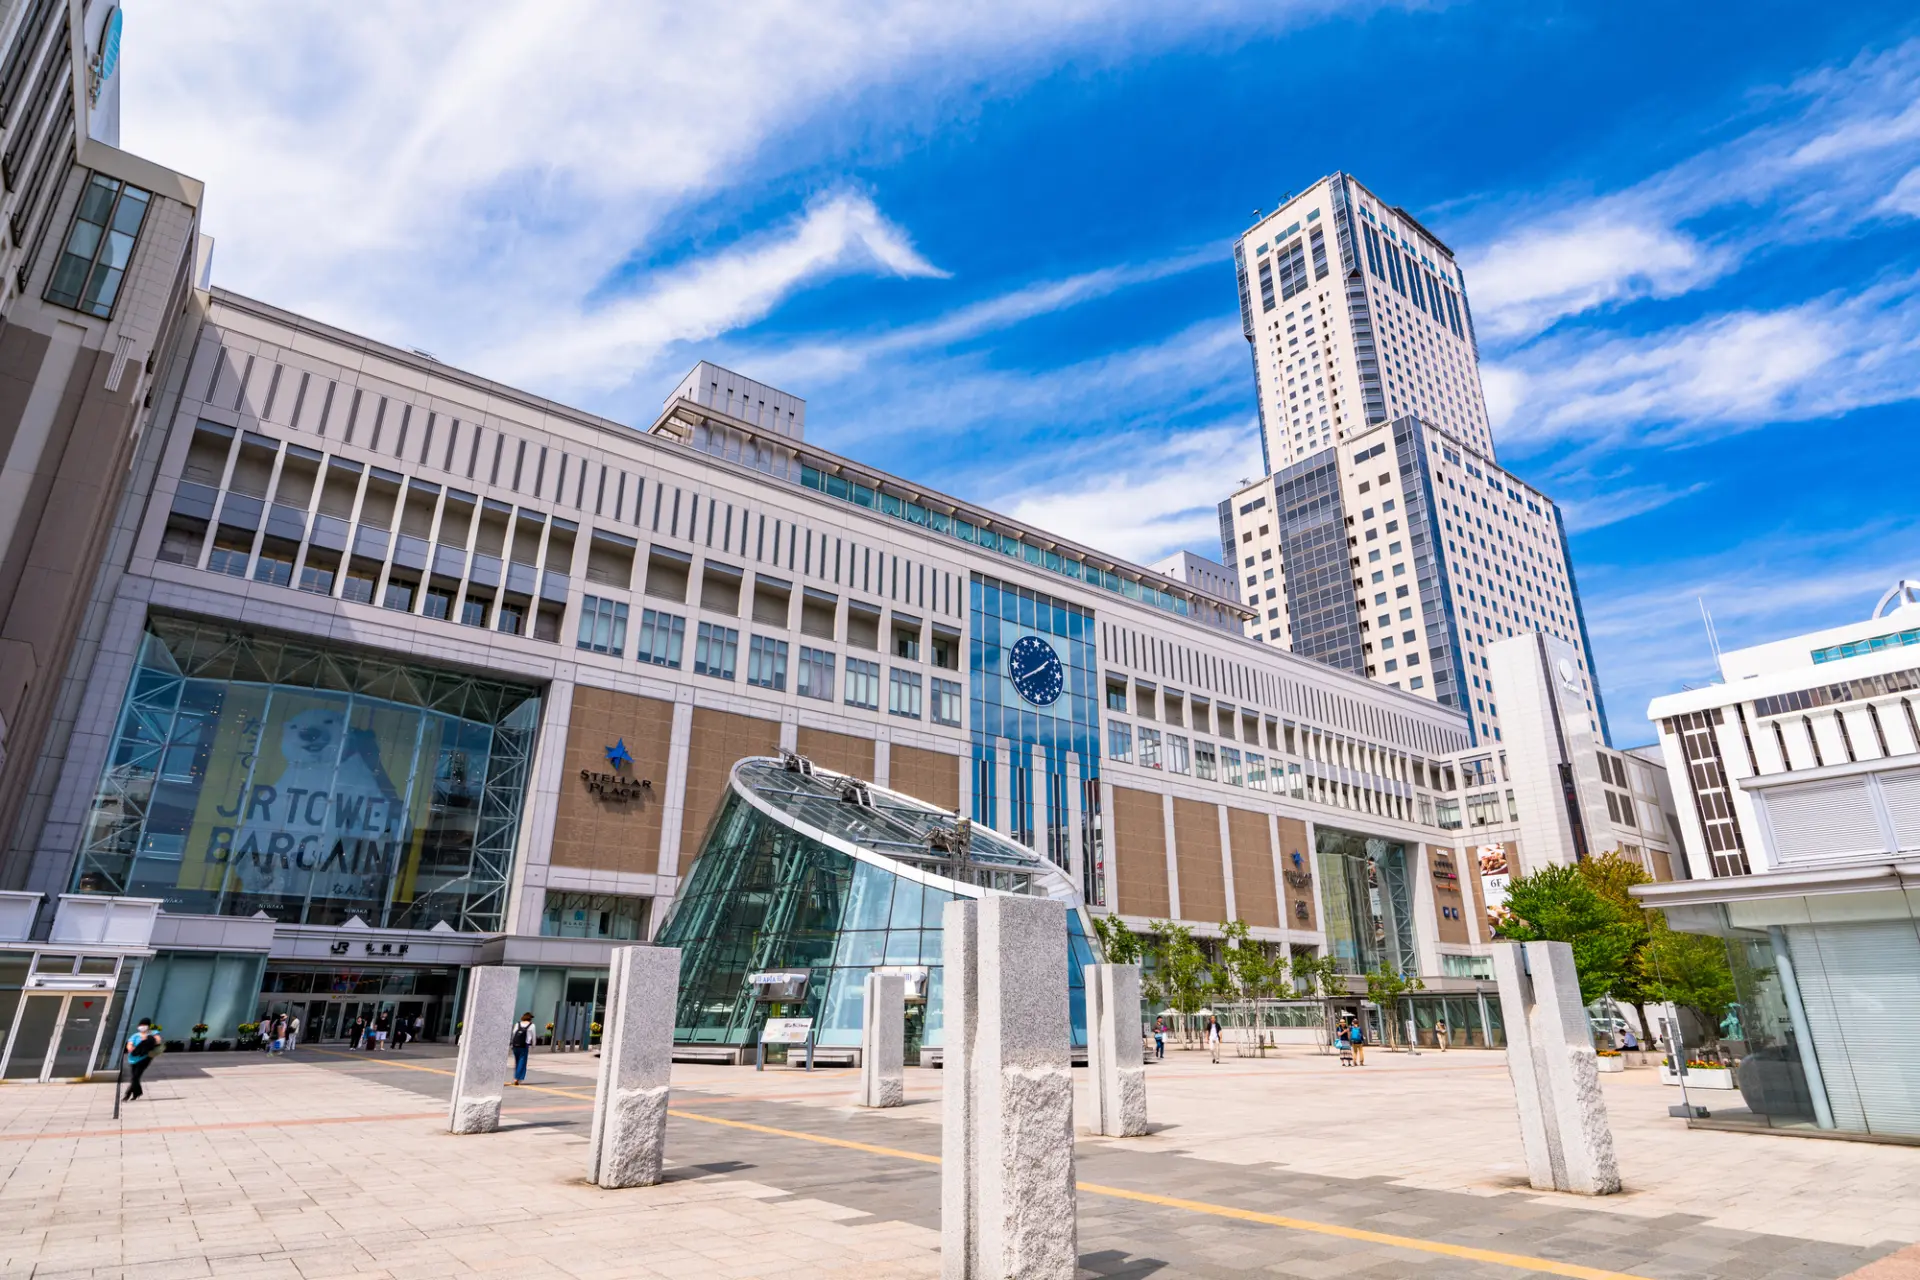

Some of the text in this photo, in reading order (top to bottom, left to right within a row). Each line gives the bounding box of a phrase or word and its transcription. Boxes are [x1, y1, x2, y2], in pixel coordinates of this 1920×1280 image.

[580, 769, 652, 790] STELLAR
[589, 782, 642, 798] PLACE
[216, 783, 278, 822] JR
[205, 826, 391, 875] BARGAIN
[1490, 878, 1503, 888] 6F
[330, 941, 350, 952] JR
[365, 943, 409, 953] 札幌駅
